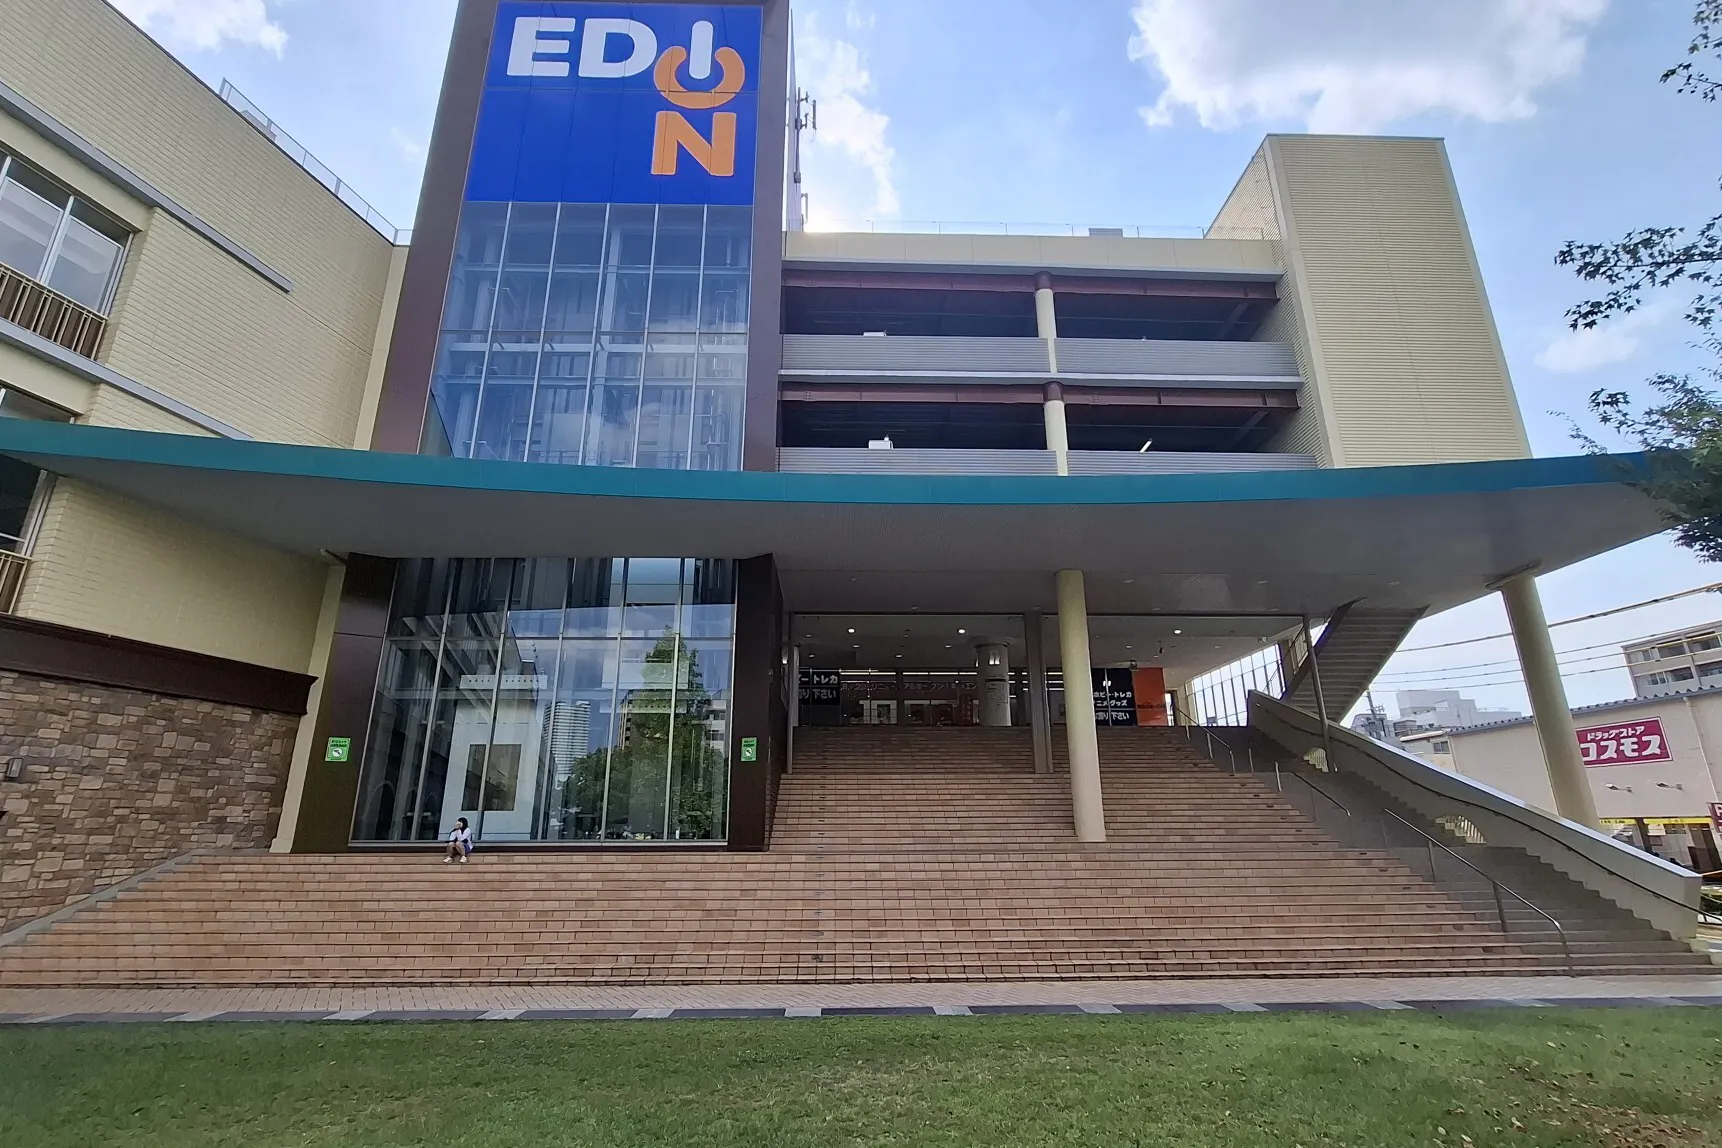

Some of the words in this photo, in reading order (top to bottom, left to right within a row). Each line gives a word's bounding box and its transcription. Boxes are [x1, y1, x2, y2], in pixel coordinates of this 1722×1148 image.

[1587, 725, 1645, 741] ドラッグストア
[1580, 734, 1661, 762] コスモス
